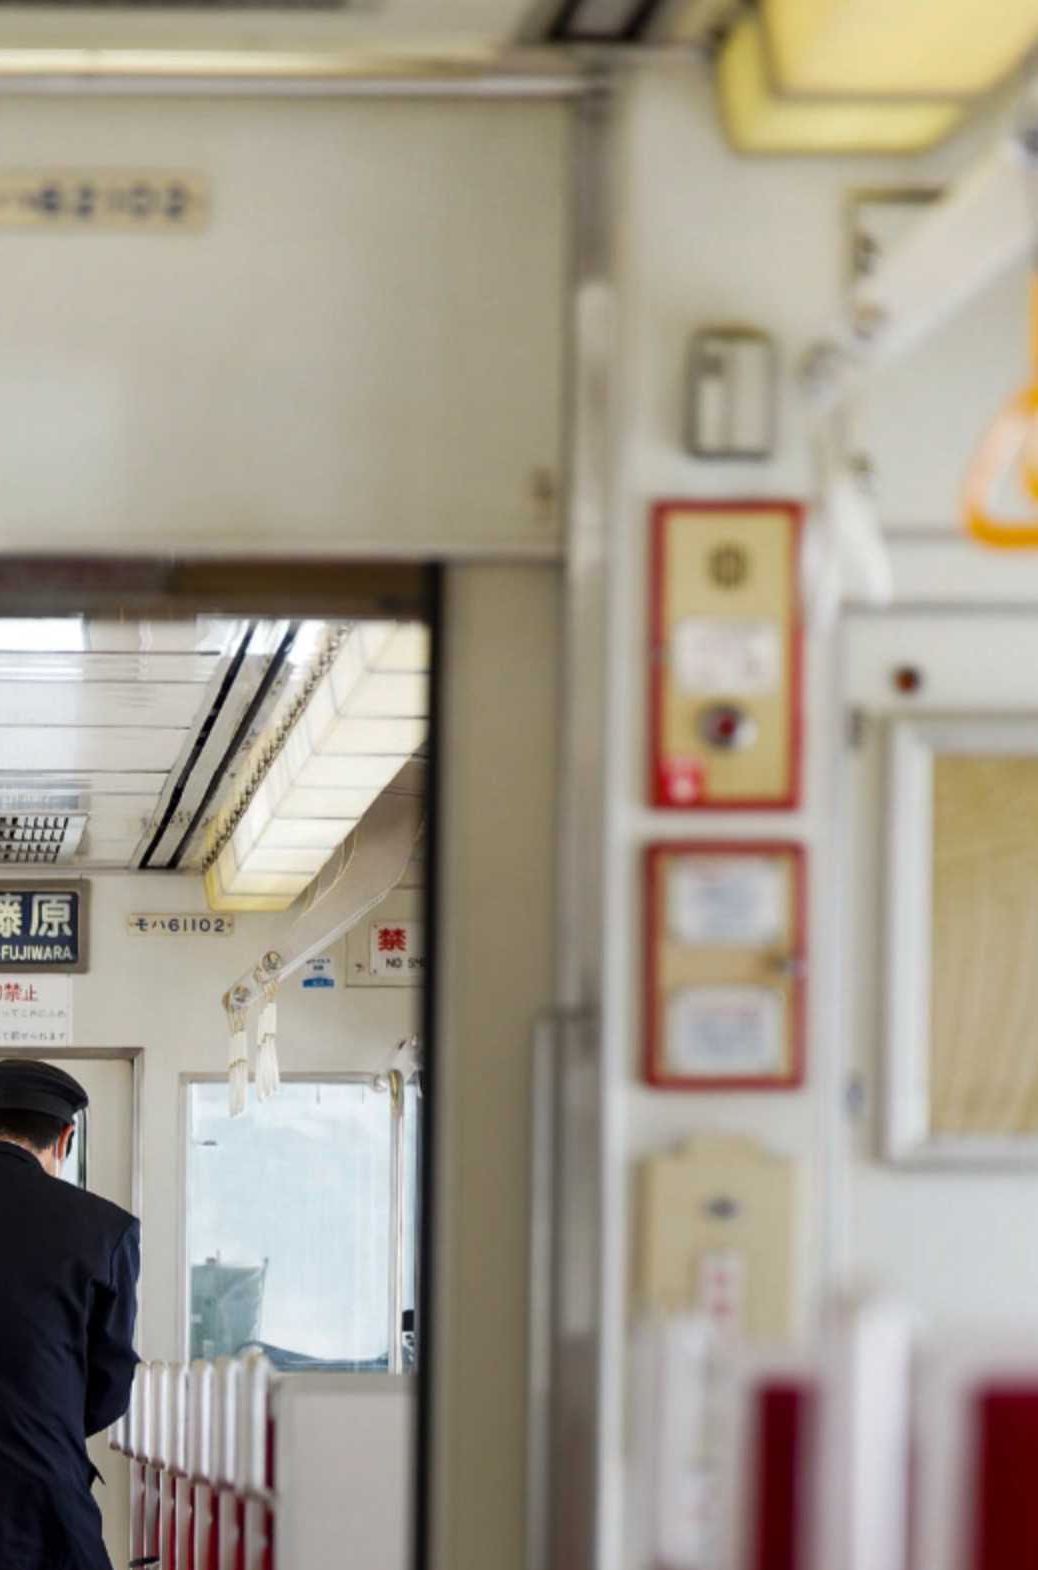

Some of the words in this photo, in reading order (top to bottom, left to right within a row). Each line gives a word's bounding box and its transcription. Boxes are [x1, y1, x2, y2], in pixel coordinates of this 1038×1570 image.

[135, 918, 225, 932] モハ61102
[378, 928, 406, 952] 禁
[385, 957, 402, 968] NO
[408, 957, 426, 968] SM
